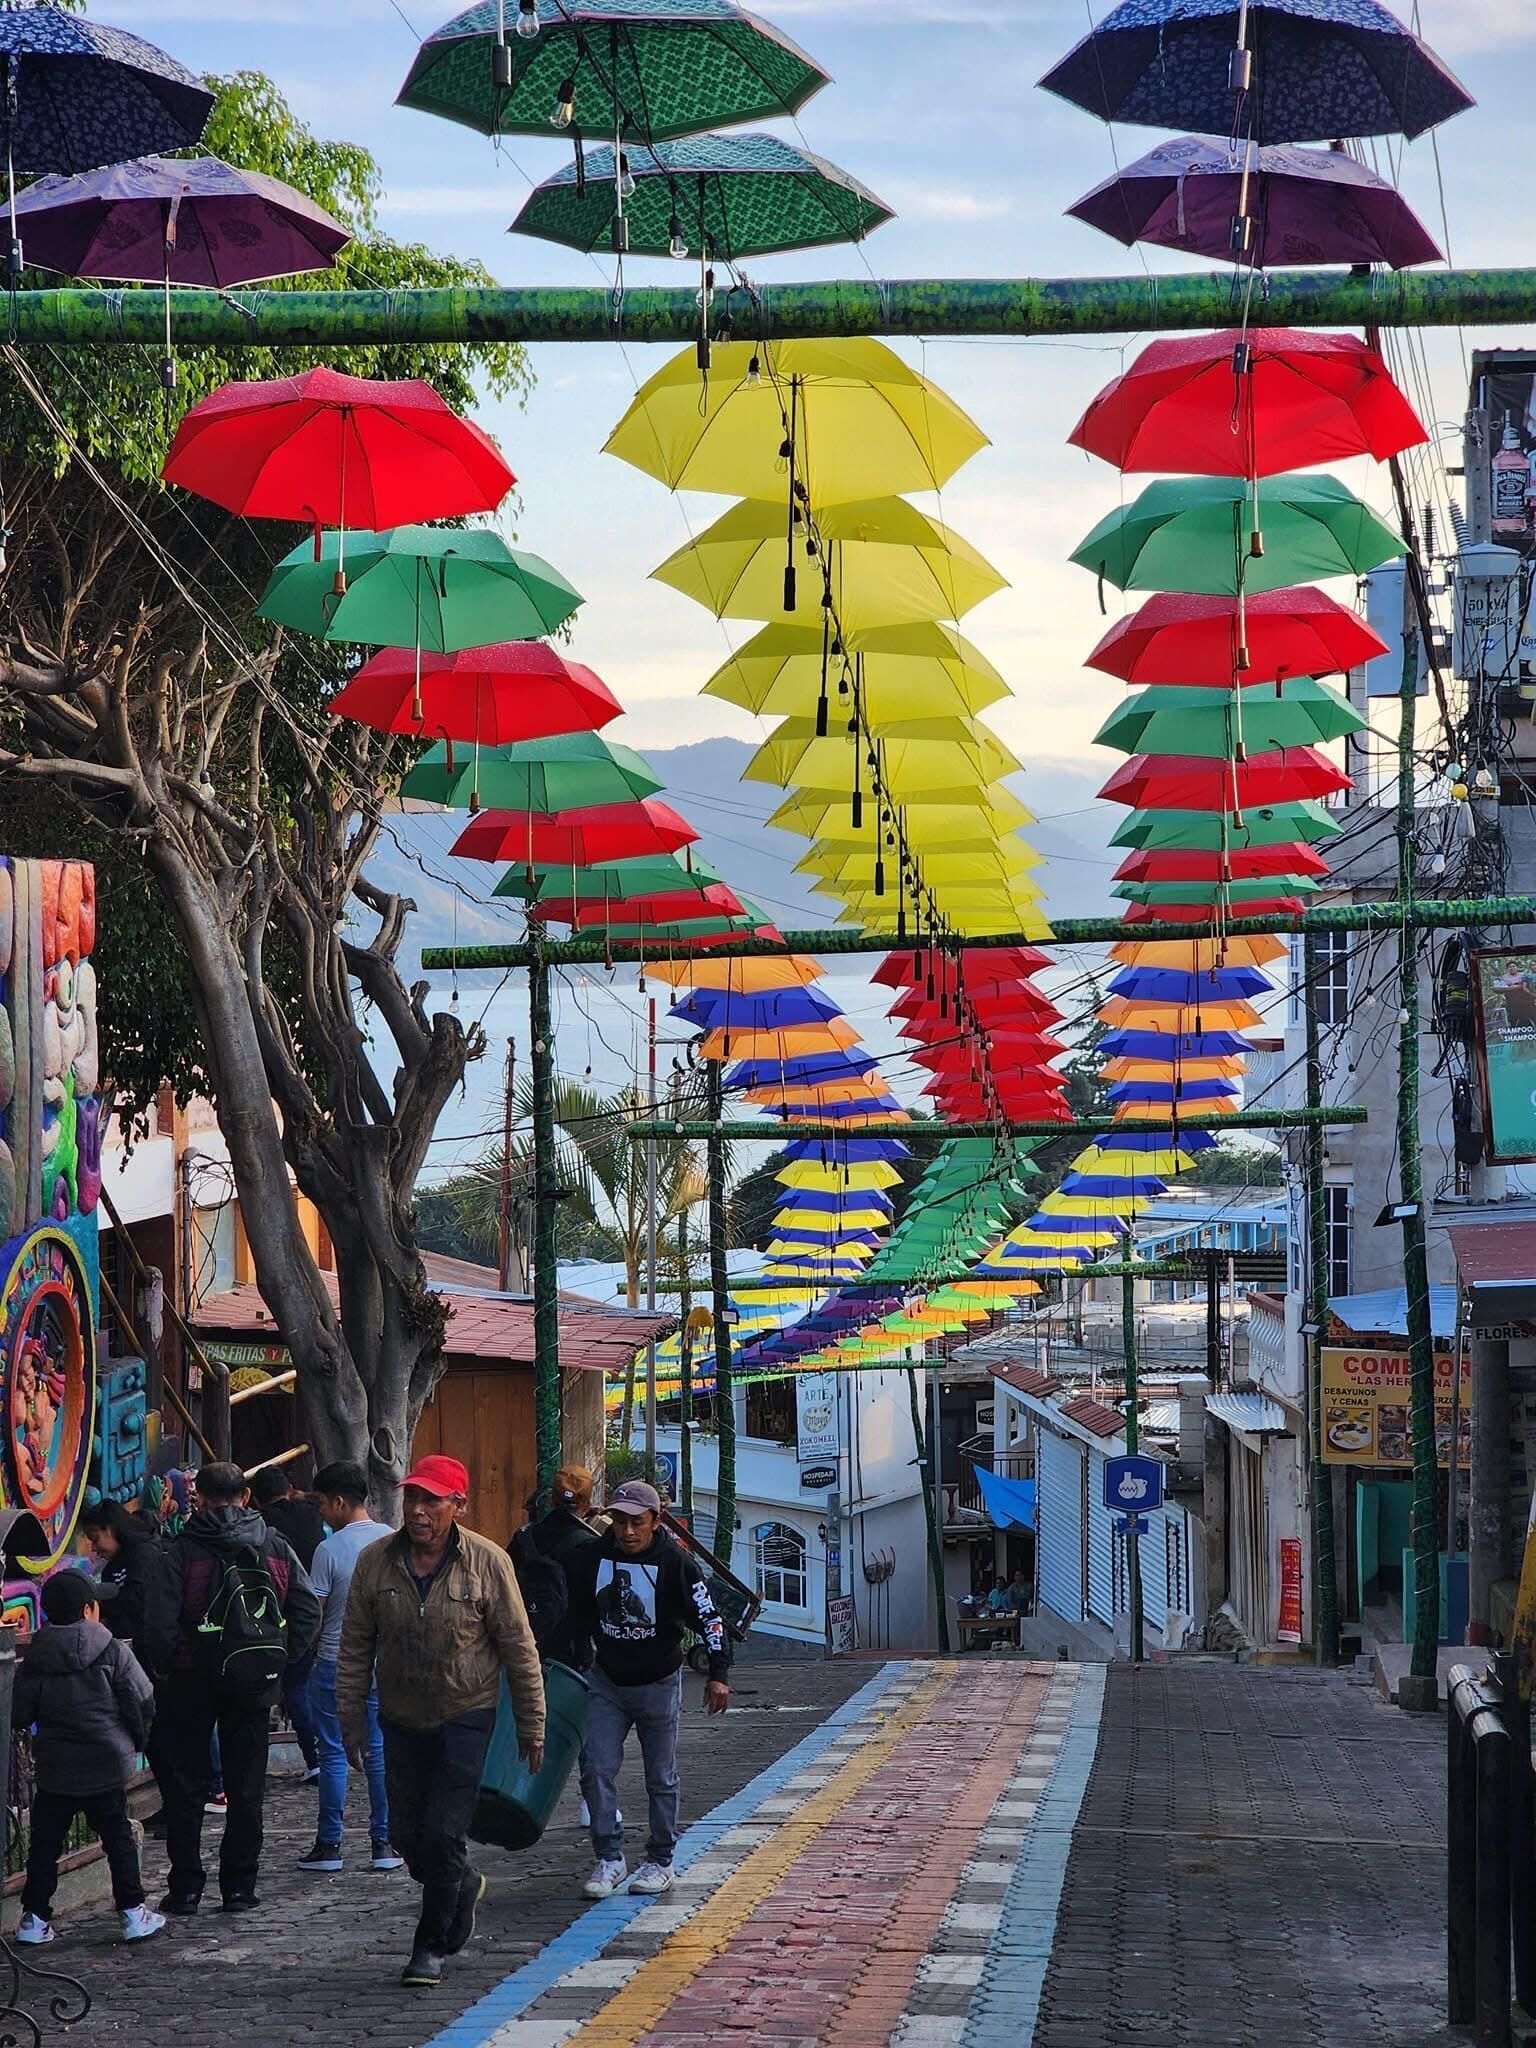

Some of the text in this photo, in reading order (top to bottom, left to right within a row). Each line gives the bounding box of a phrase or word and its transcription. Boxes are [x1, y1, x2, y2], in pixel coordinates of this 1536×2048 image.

[1476, 1327, 1529, 1340] FLORES
[229, 1346, 266, 1362] FRITAS
[272, 1350, 279, 1360] Y
[1343, 1356, 1471, 1378] COMEOR
[804, 1388, 830, 1402] ARTE
[1324, 1387, 1377, 1397] DESAYUNOS
[1340, 1398, 1369, 1406] CENAS
[803, 1470, 834, 1481] HOSPEDAJE
